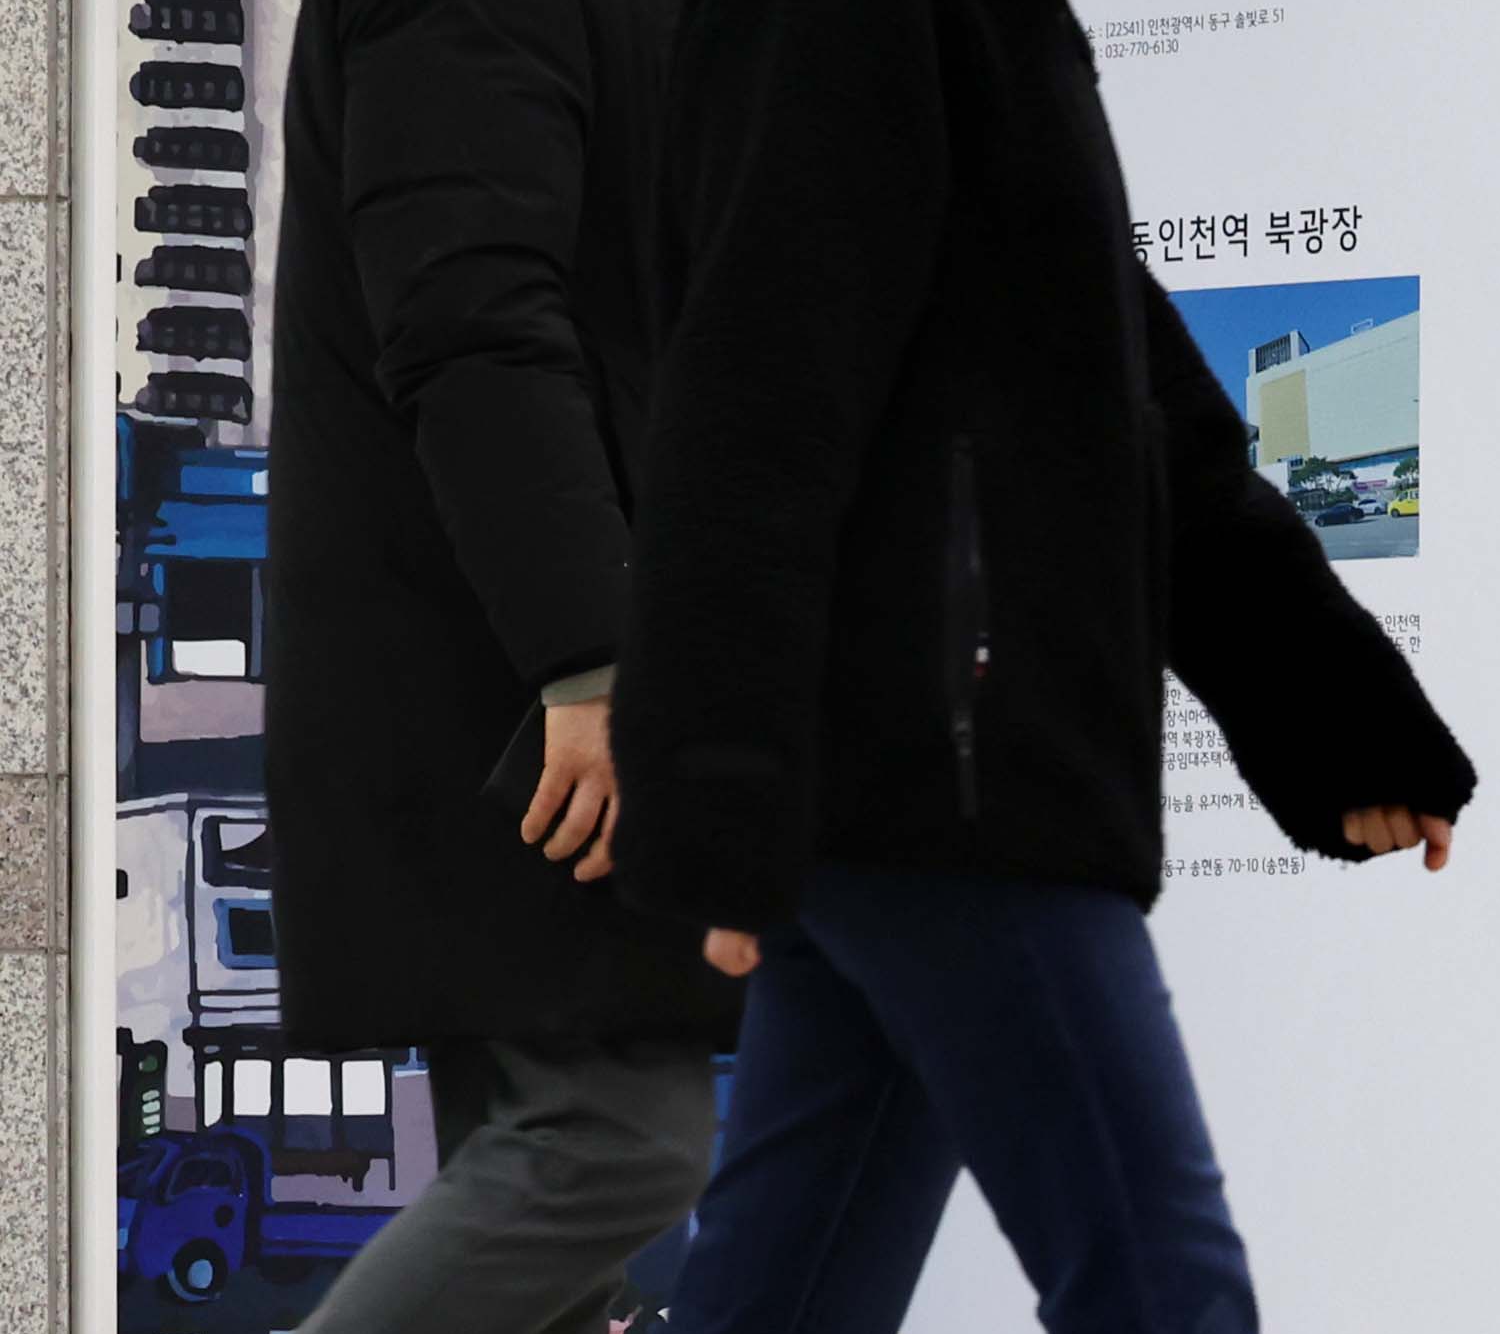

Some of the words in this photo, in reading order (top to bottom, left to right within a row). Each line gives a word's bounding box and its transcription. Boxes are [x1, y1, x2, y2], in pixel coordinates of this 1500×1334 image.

[1106, 18, 1144, 39] [22541]
[1147, 14, 1204, 37] 인천광역시
[1208, 12, 1230, 32] 동구
[1234, 8, 1269, 30] 솔빛로
[1273, 7, 1284, 24] 51
[1130, 213, 1248, 267] 동인천역
[1265, 205, 1363, 255] 북광장
[1191, 858, 1224, 877] 송현동
[1228, 857, 1259, 874] 70-10
[1262, 856, 1306, 876] (송현동)
